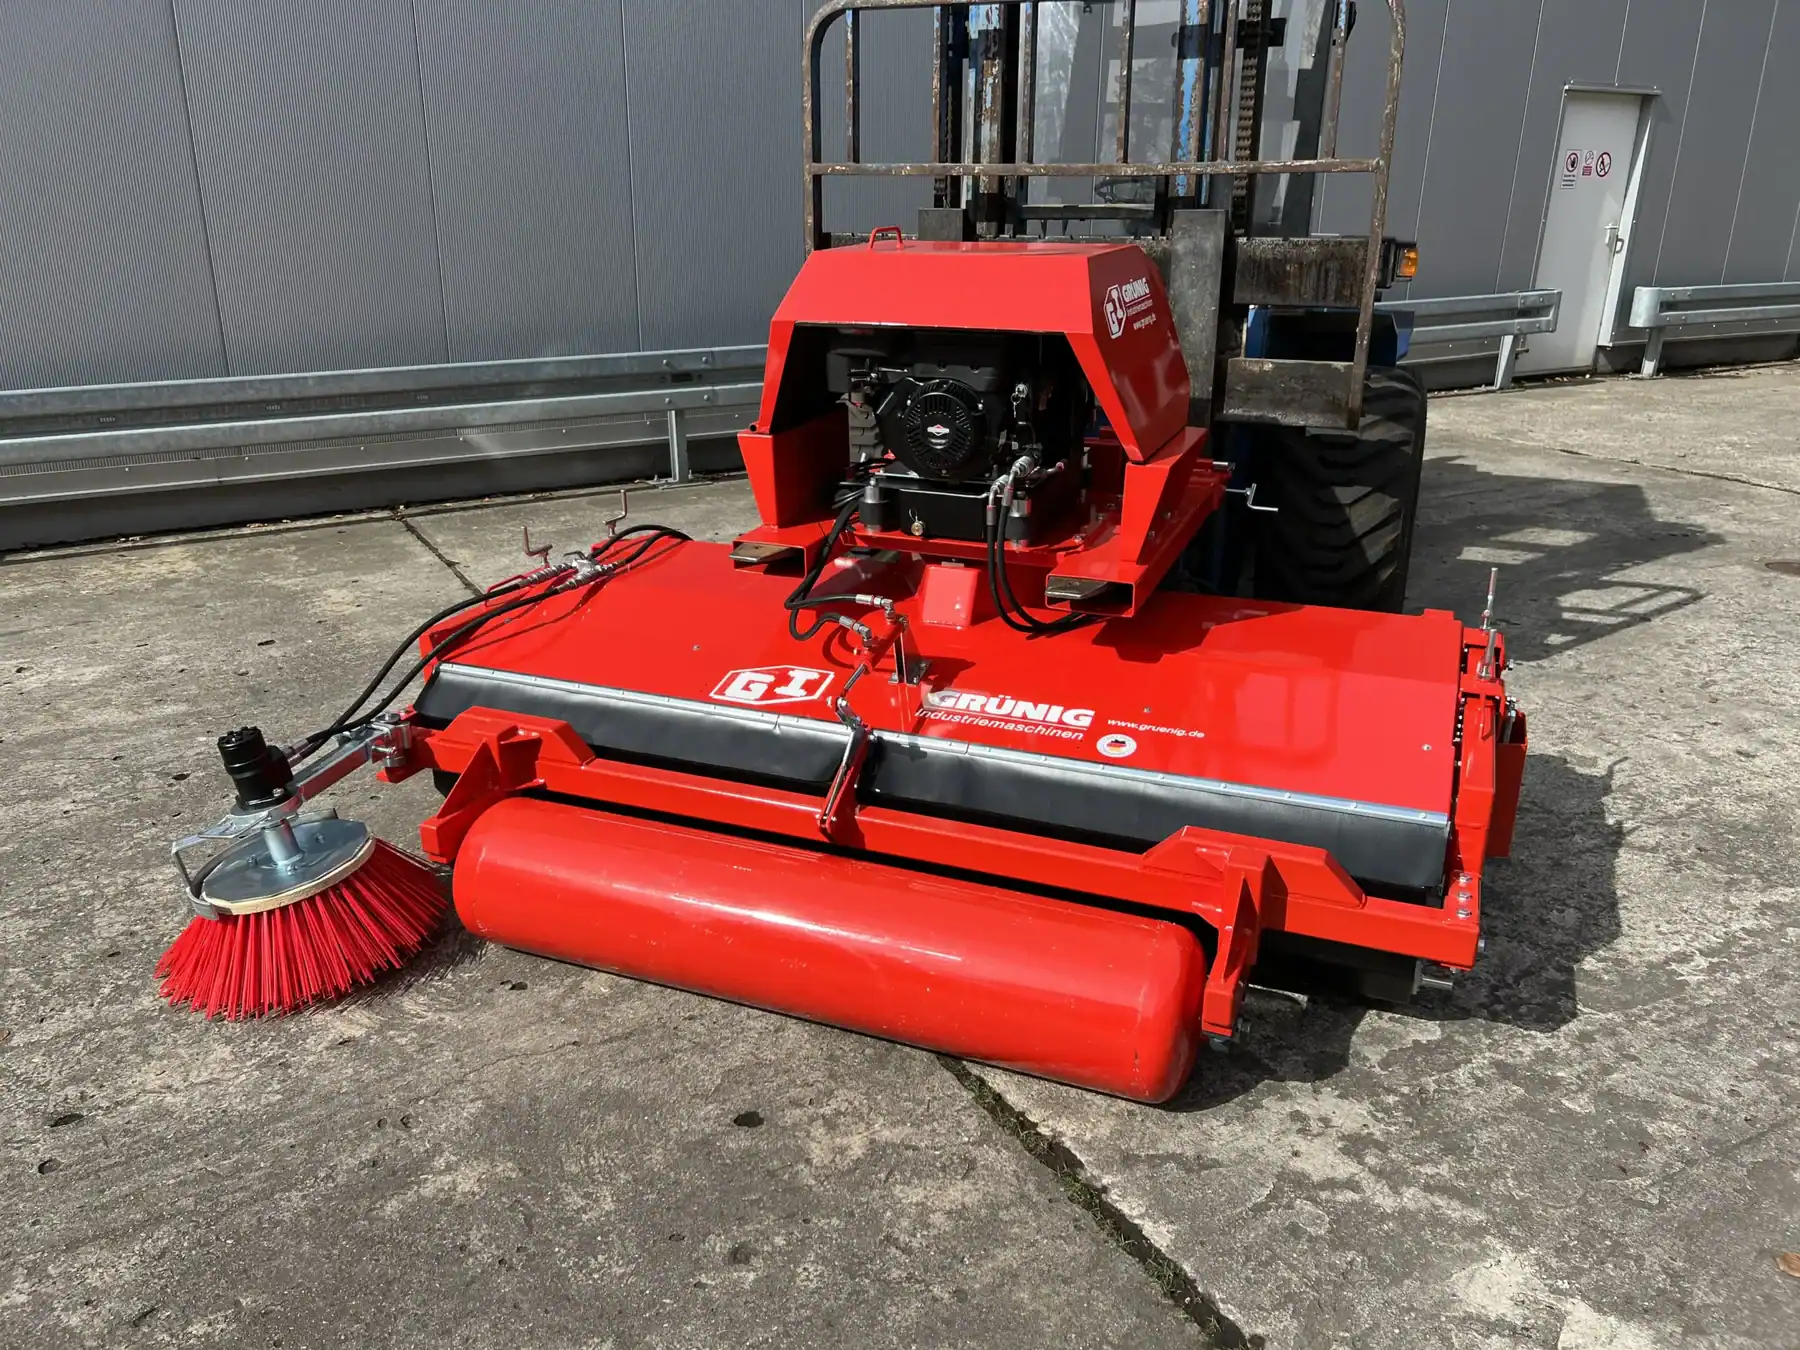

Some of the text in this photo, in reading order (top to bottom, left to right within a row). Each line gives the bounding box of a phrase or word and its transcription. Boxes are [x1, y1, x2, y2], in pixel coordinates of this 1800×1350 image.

[915, 708, 1083, 740] Industriemaschinen
[928, 690, 1095, 728] GRÜNIG
[1107, 719, 1205, 738] www.gruenig.de
